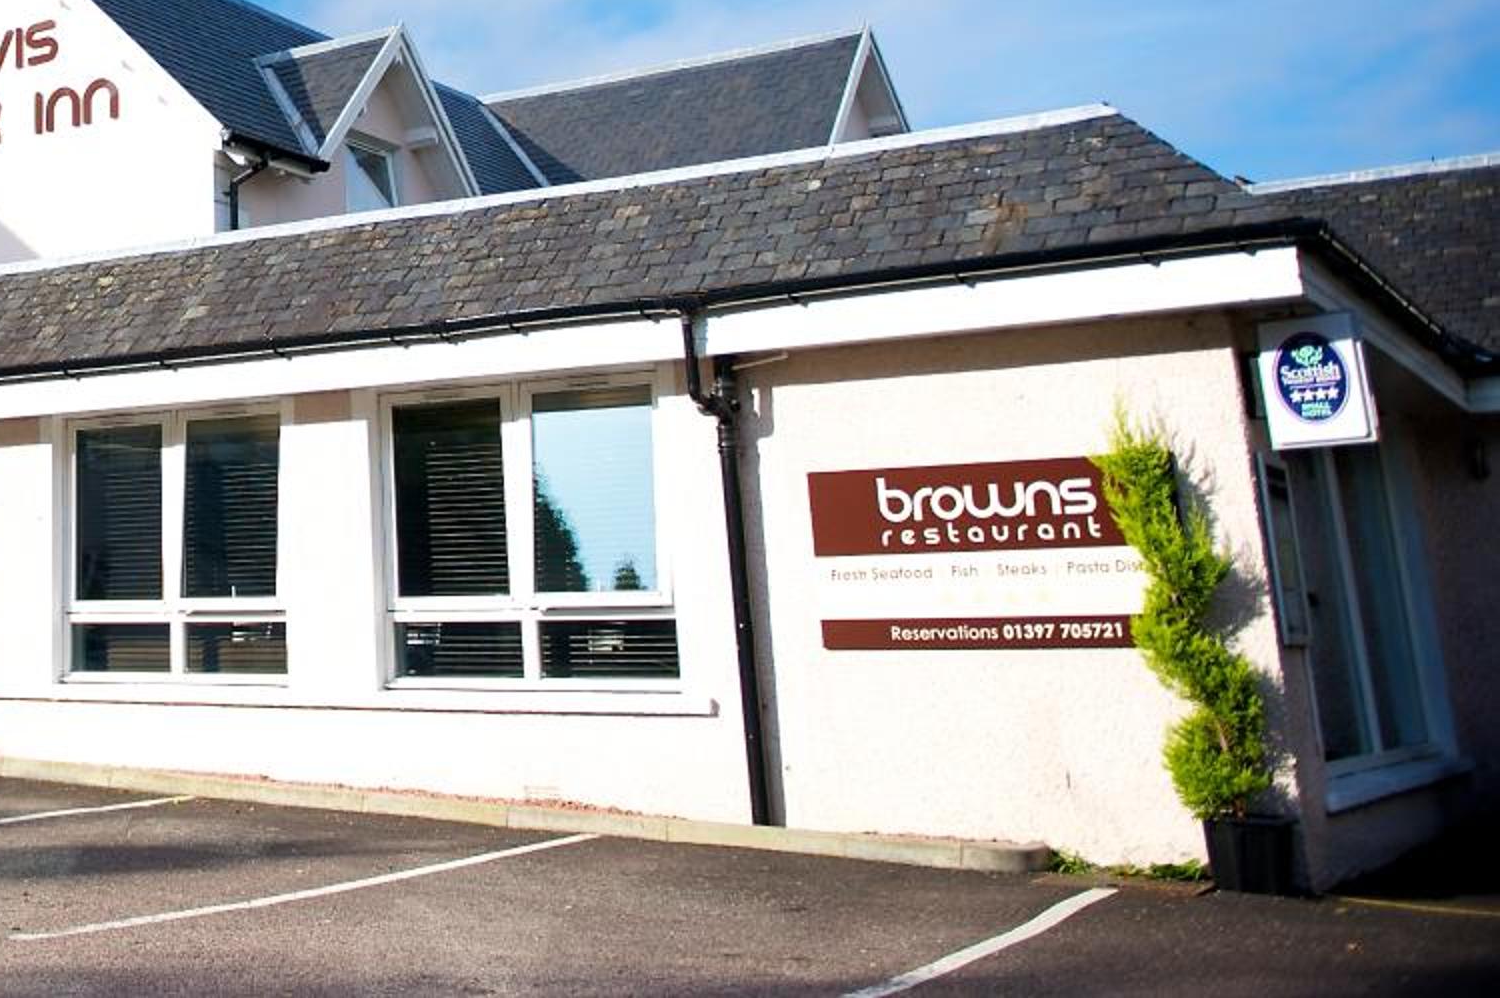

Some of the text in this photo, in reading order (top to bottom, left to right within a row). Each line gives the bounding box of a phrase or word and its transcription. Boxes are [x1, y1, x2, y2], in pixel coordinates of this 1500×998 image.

[35, 78, 120, 134] inn
[1281, 362, 1340, 379] Scottish
[875, 477, 1098, 523] browns
[881, 515, 1102, 547] restaurant
[831, 569, 867, 581] Fresh
[871, 567, 933, 581] Seafood
[951, 564, 978, 577] Fish
[997, 562, 1047, 576] Steaks
[1067, 560, 1110, 575] Pasta
[891, 621, 1124, 641] Reservations 01397 705721
